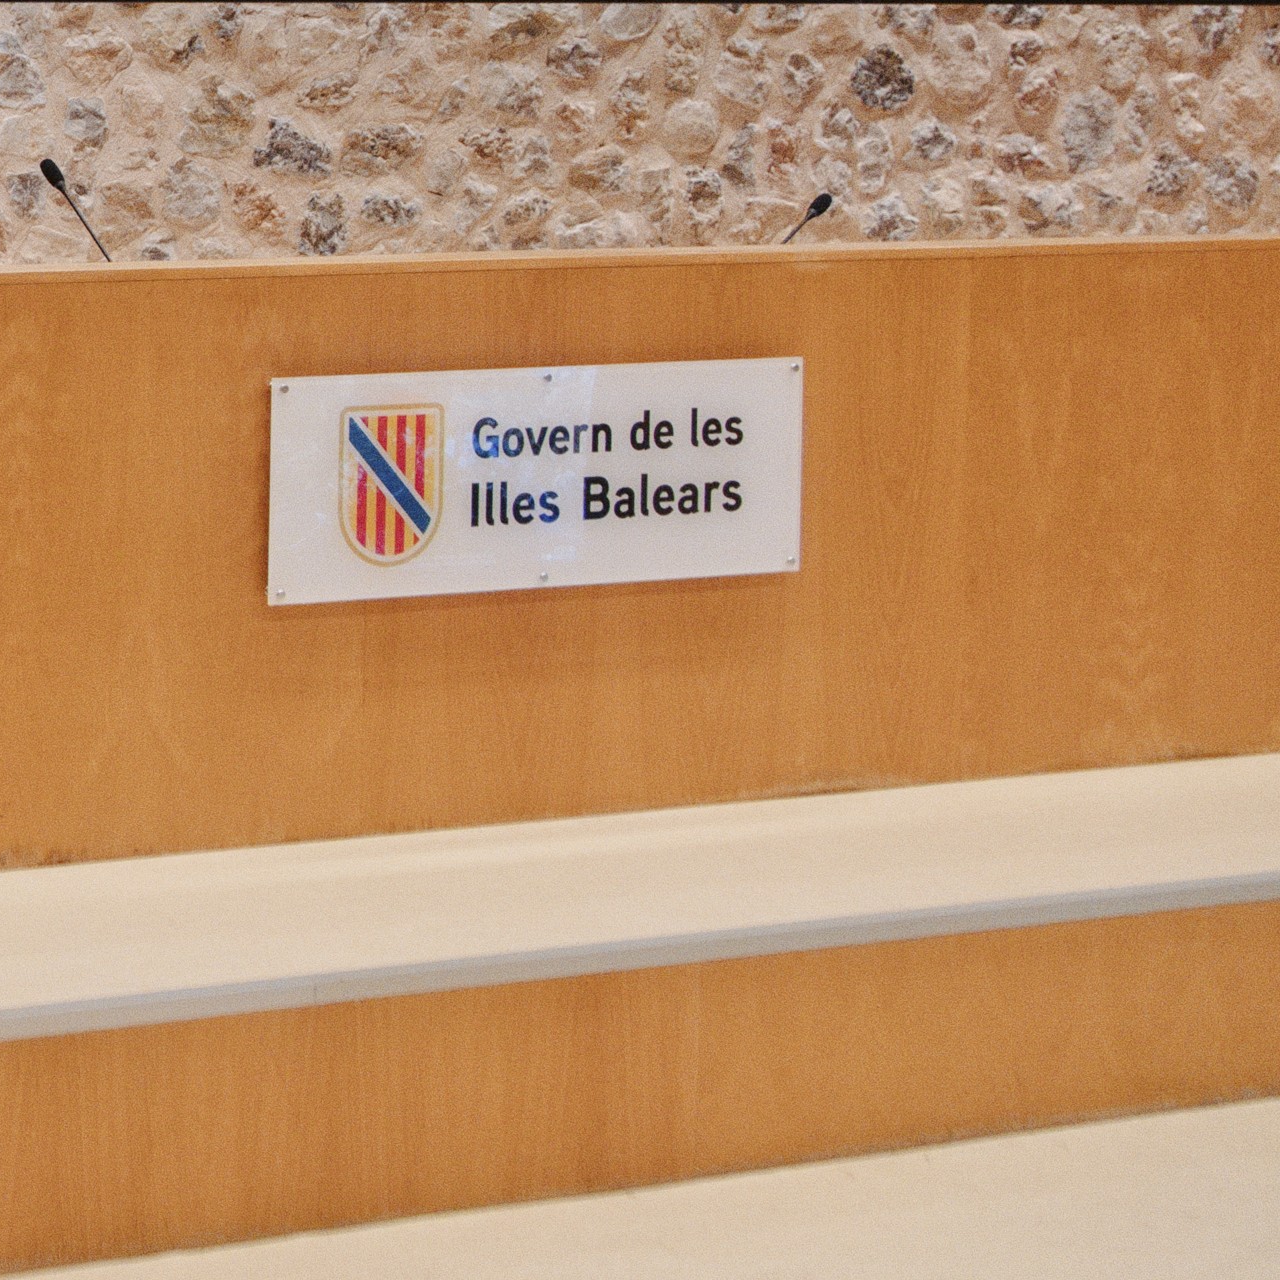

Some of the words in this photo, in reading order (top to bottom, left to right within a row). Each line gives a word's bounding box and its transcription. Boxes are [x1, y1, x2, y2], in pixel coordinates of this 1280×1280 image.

[472, 417, 612, 459] Govern
[630, 410, 674, 451] de
[691, 407, 744, 447] les
[471, 481, 560, 527] Illes
[583, 473, 743, 520] Balears
